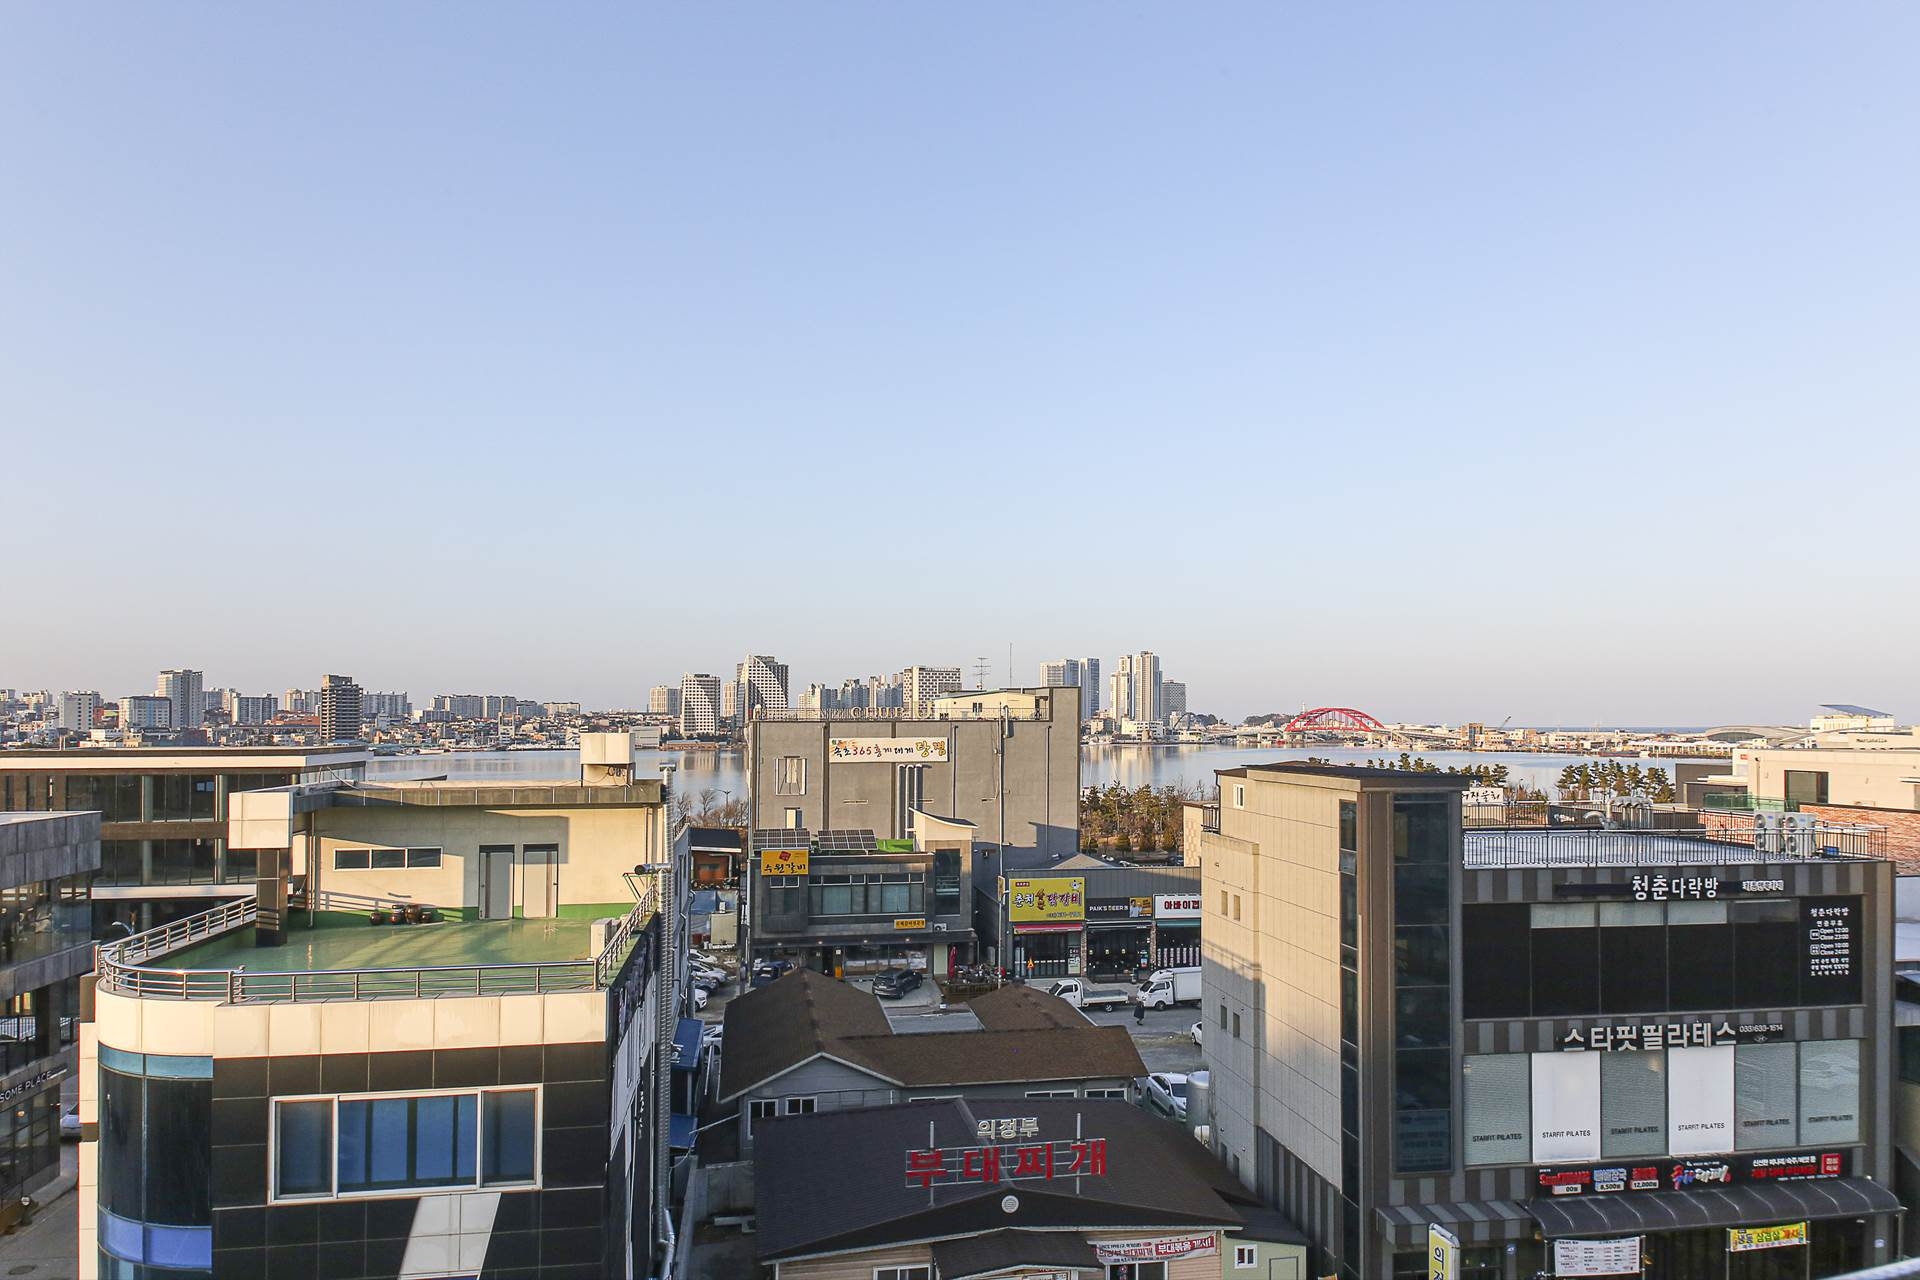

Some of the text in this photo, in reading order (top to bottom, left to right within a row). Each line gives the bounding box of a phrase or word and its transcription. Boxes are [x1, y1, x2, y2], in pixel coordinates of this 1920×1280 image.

[763, 861, 807, 875] 수원갈비
[1632, 874, 1719, 900] 청춘다락방
[1810, 907, 1850, 917] 청춘다락방
[1563, 1021, 1737, 1052] 스타핏필라테스
[25, 1070, 52, 1091] PLACE
[976, 1117, 1040, 1140] 의정부
[1700, 1122, 1725, 1130] PILATES
[1496, 1133, 1522, 1141] PILATES
[904, 1139, 1107, 1190] 부대찌개
